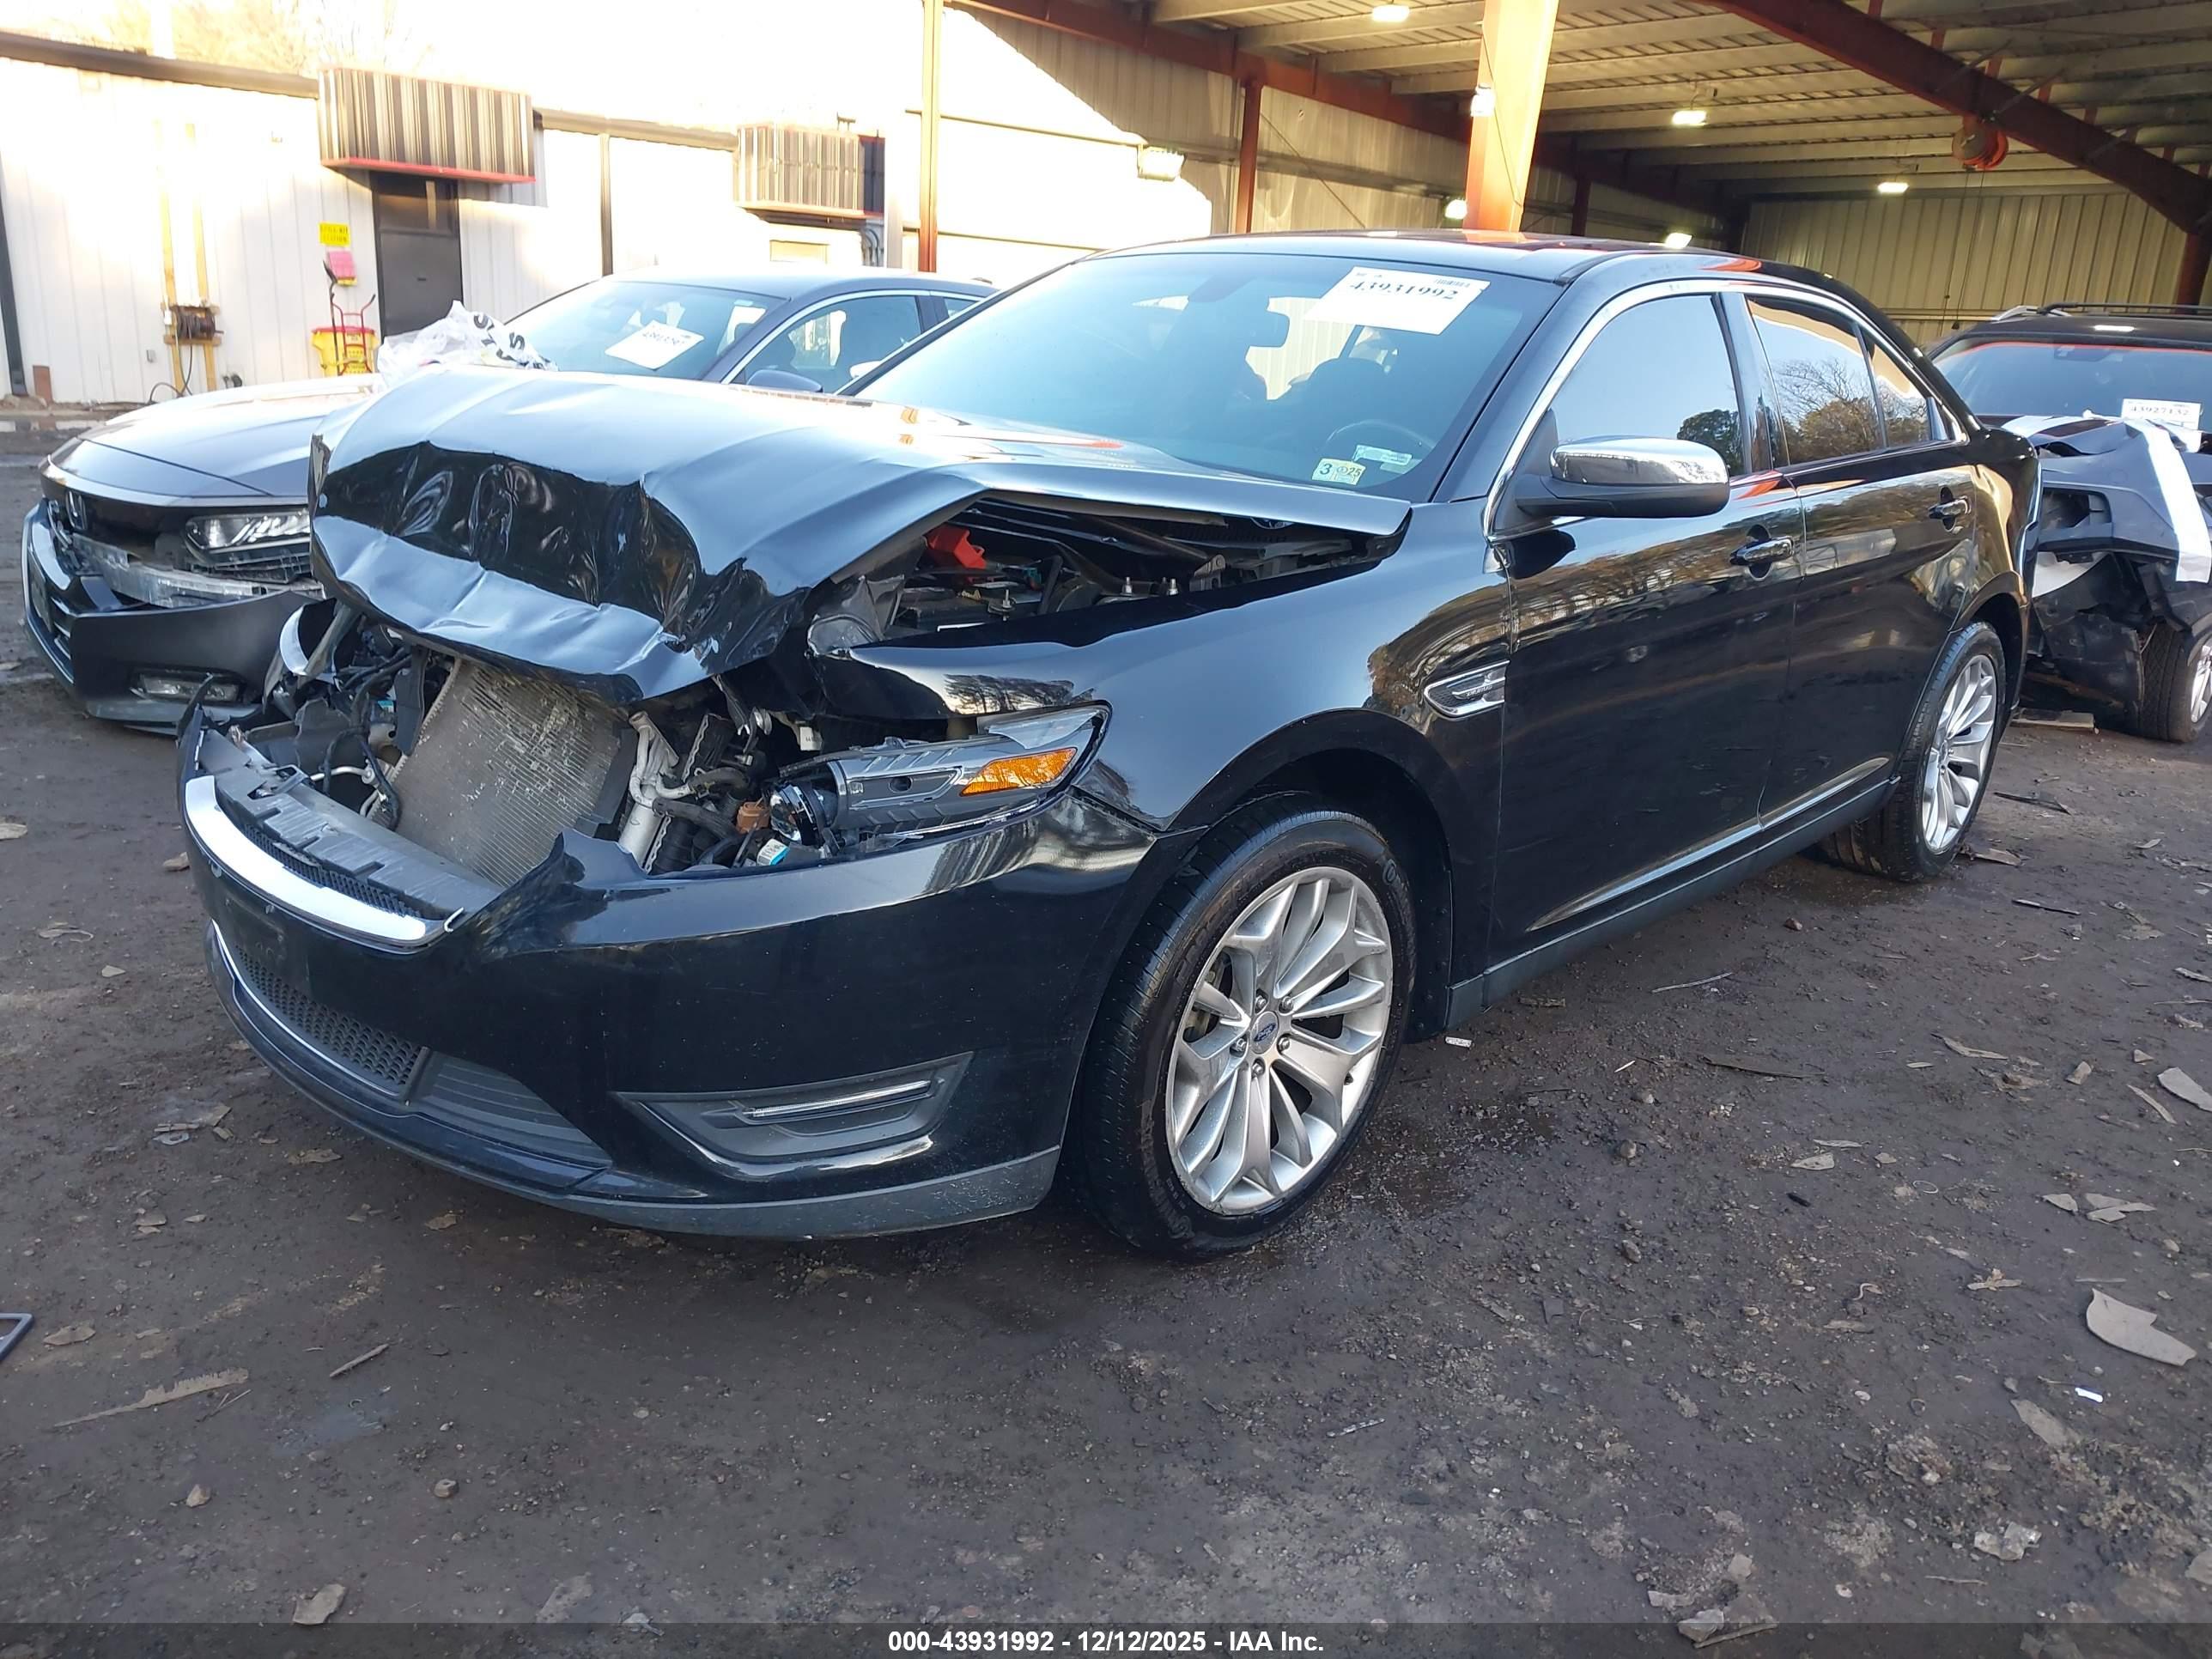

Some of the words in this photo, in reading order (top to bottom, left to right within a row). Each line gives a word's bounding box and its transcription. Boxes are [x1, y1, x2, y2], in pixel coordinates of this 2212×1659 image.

[1351, 281, 1459, 300] 43931992
[1320, 463, 1333, 475] 3
[1347, 467, 1362, 476] 25
